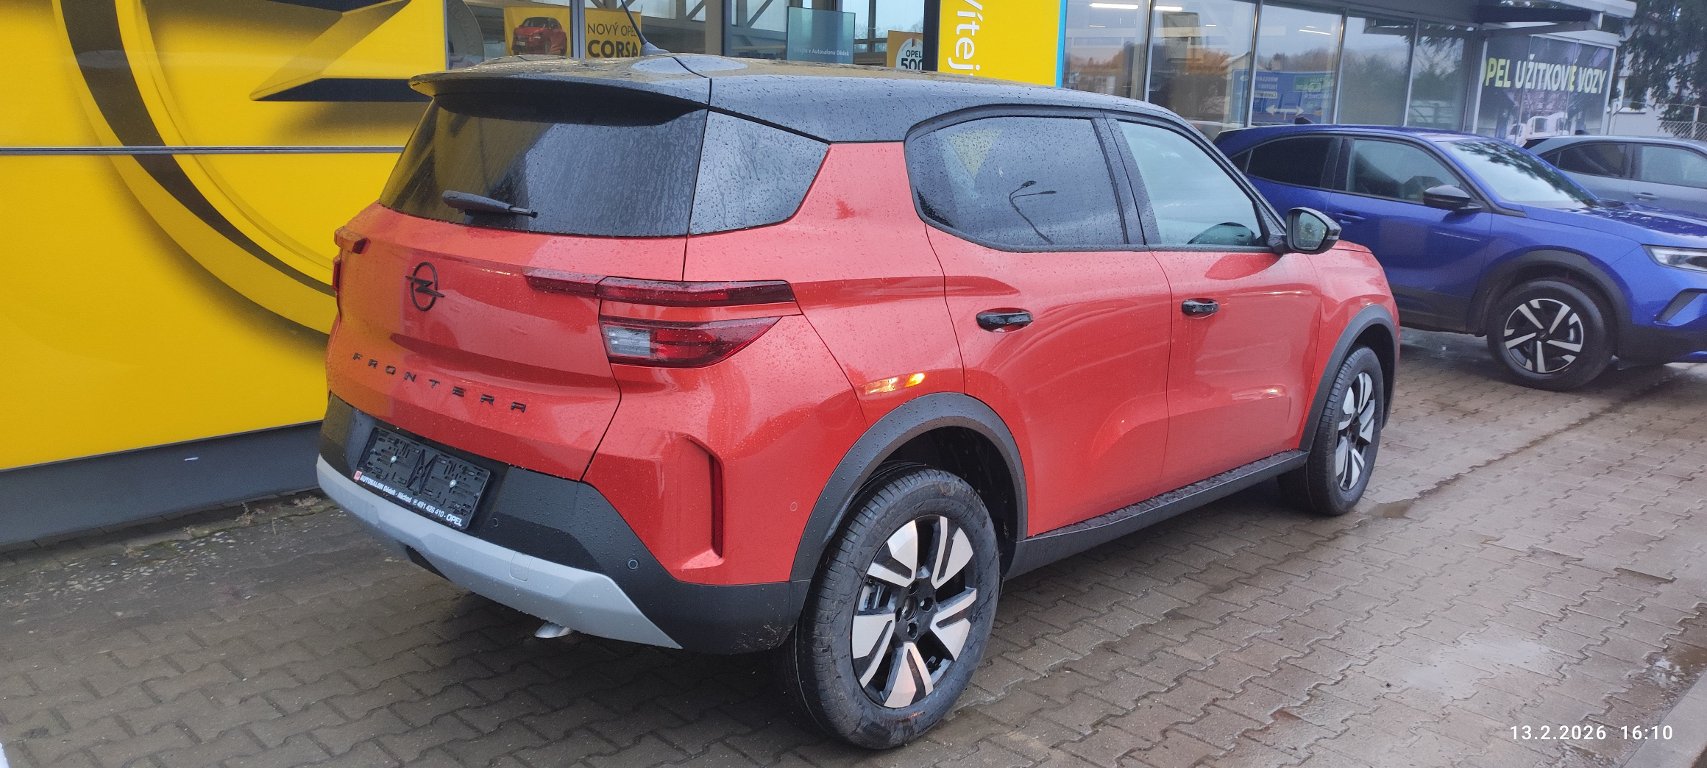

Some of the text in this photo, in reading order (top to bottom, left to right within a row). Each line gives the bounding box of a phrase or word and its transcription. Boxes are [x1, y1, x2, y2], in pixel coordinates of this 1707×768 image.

[587, 22, 618, 35] NOVÝ
[947, 0, 983, 75] ítej
[587, 39, 639, 58] CORSA
[905, 49, 922, 58] OPEL
[1514, 53, 1578, 92] UŽITKOVÉ
[1577, 66, 1607, 94] VOZY
[352, 352, 527, 413] FRONTERA
[445, 513, 462, 527] OPEL
